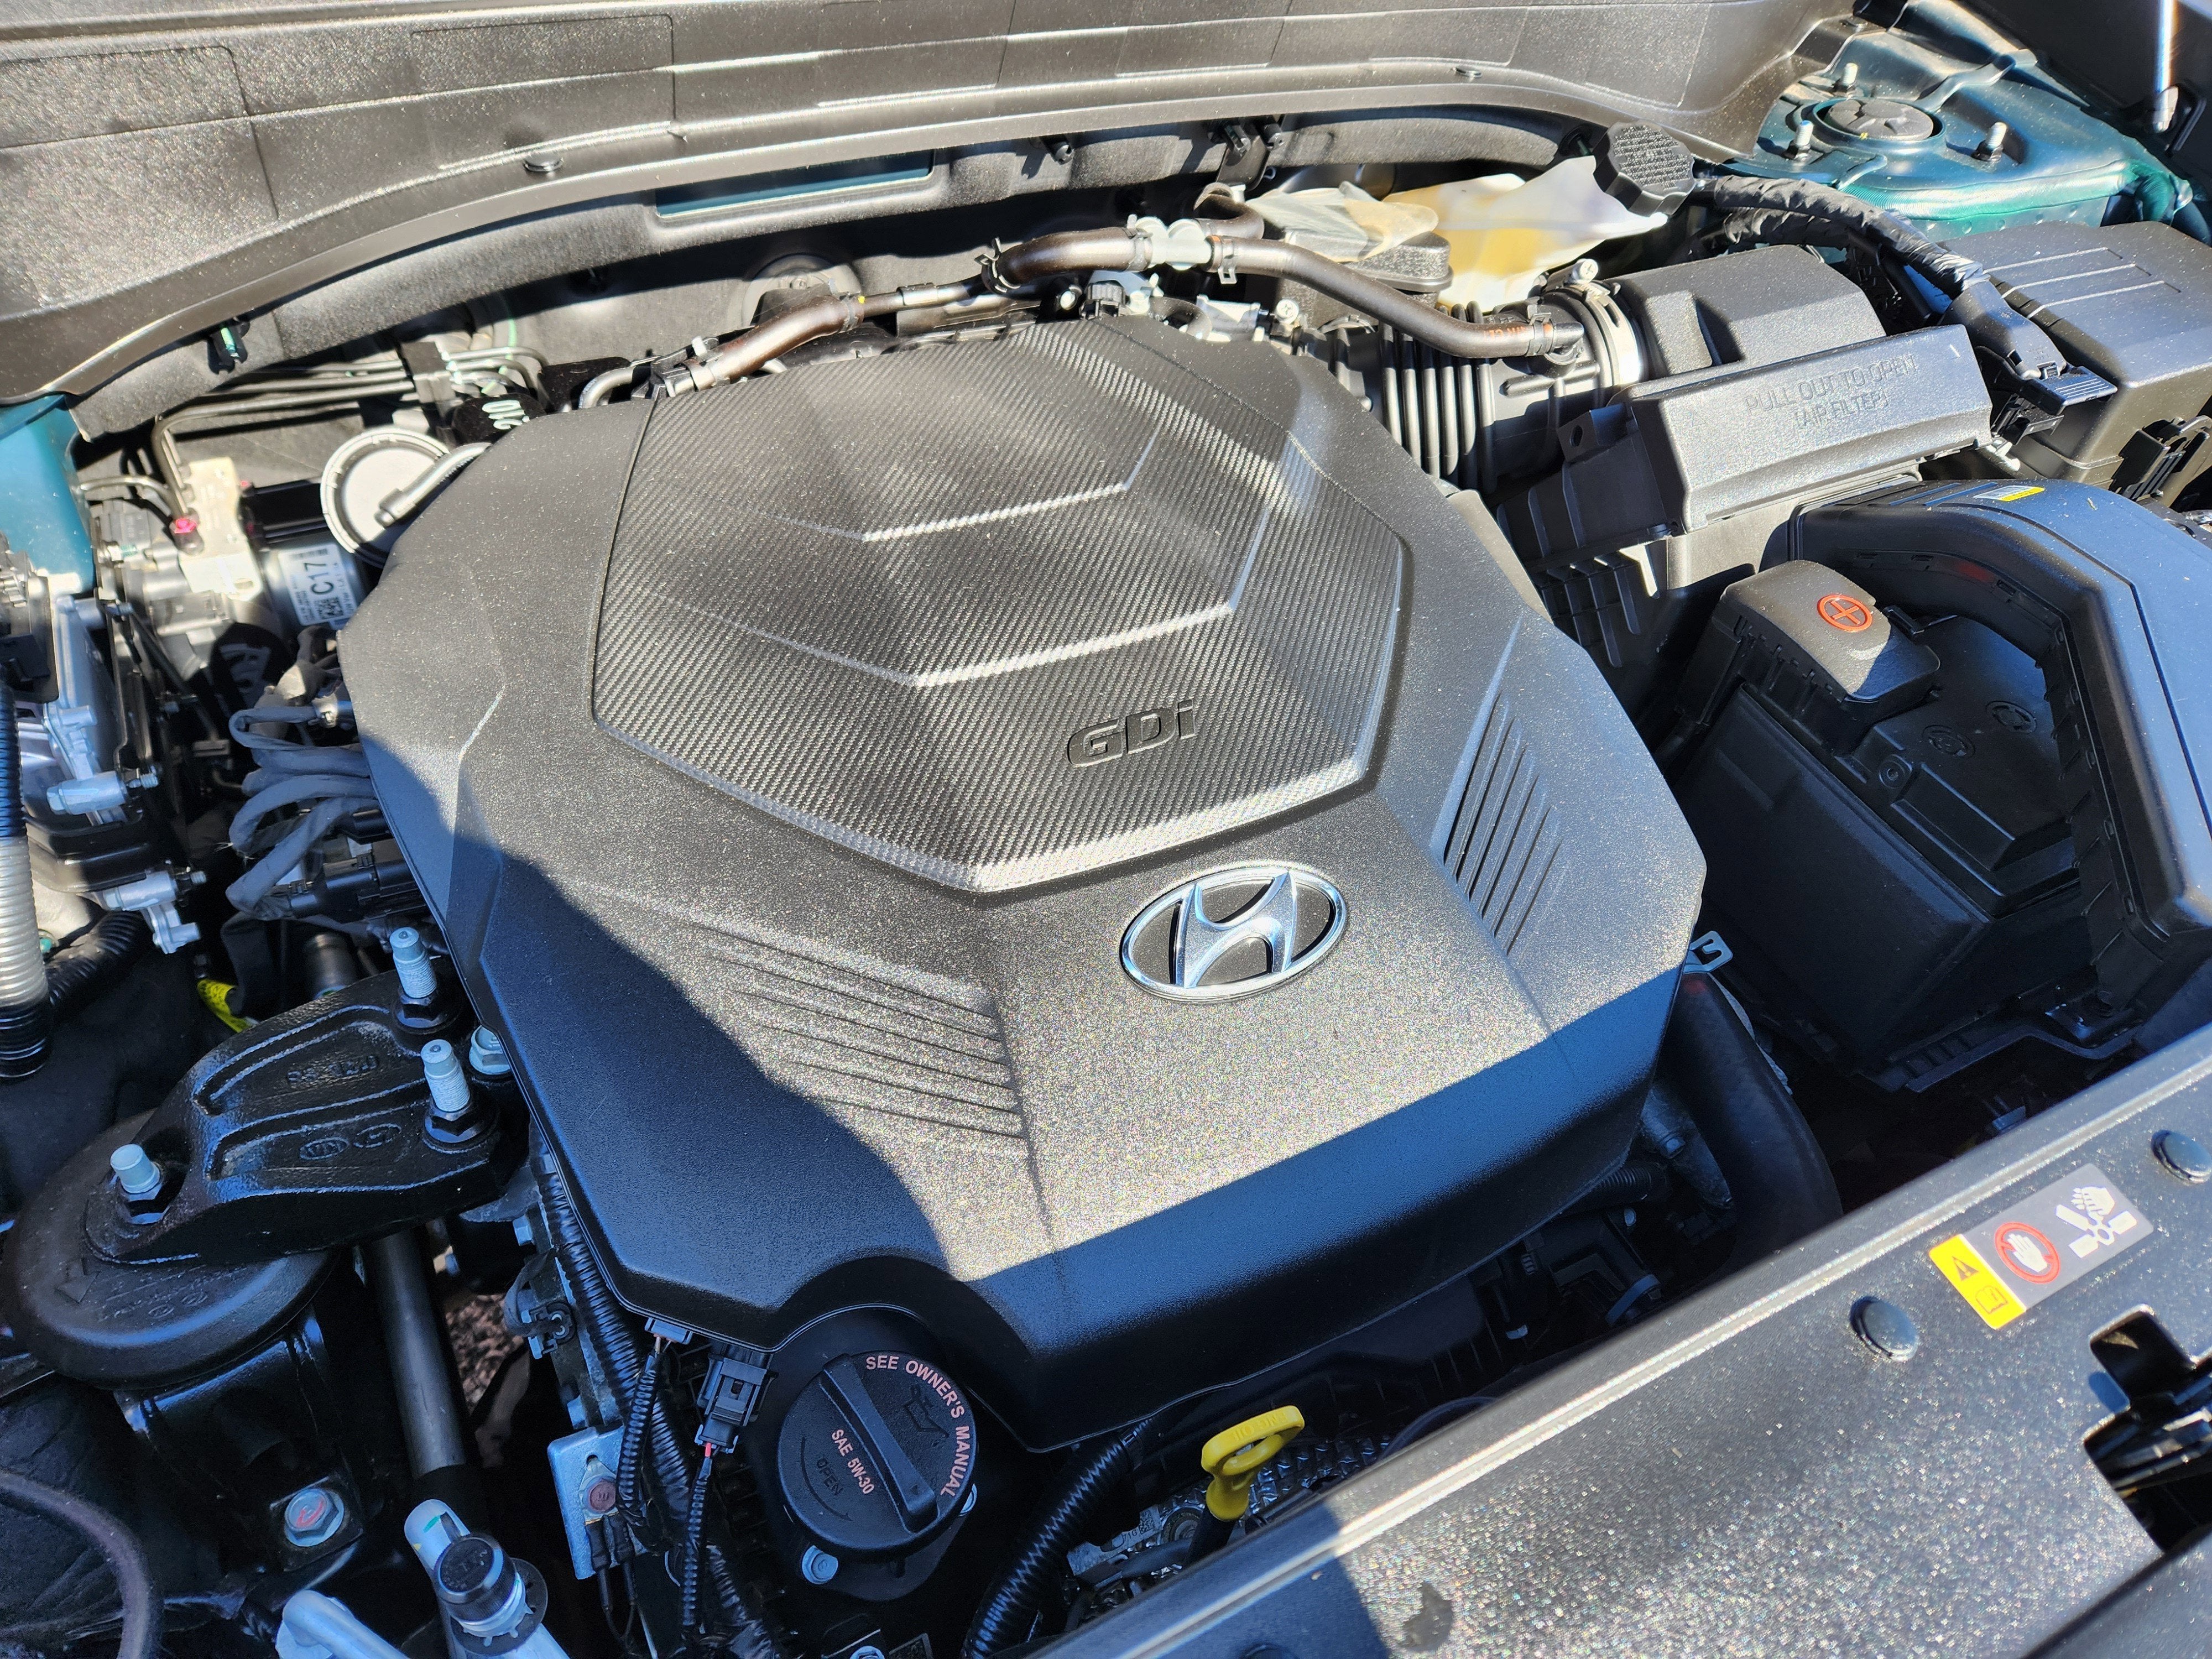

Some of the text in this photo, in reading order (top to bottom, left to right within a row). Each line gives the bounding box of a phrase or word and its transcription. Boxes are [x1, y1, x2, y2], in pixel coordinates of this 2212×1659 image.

[1744, 354, 1917, 416] PULL OUT TO OPEN
[304, 562, 334, 596] C17
[866, 1355, 970, 1496] SEE OWNER'S MANUAL
[817, 1458, 844, 1495] OPEN
[832, 1429, 874, 1494] SAE 5W-30
